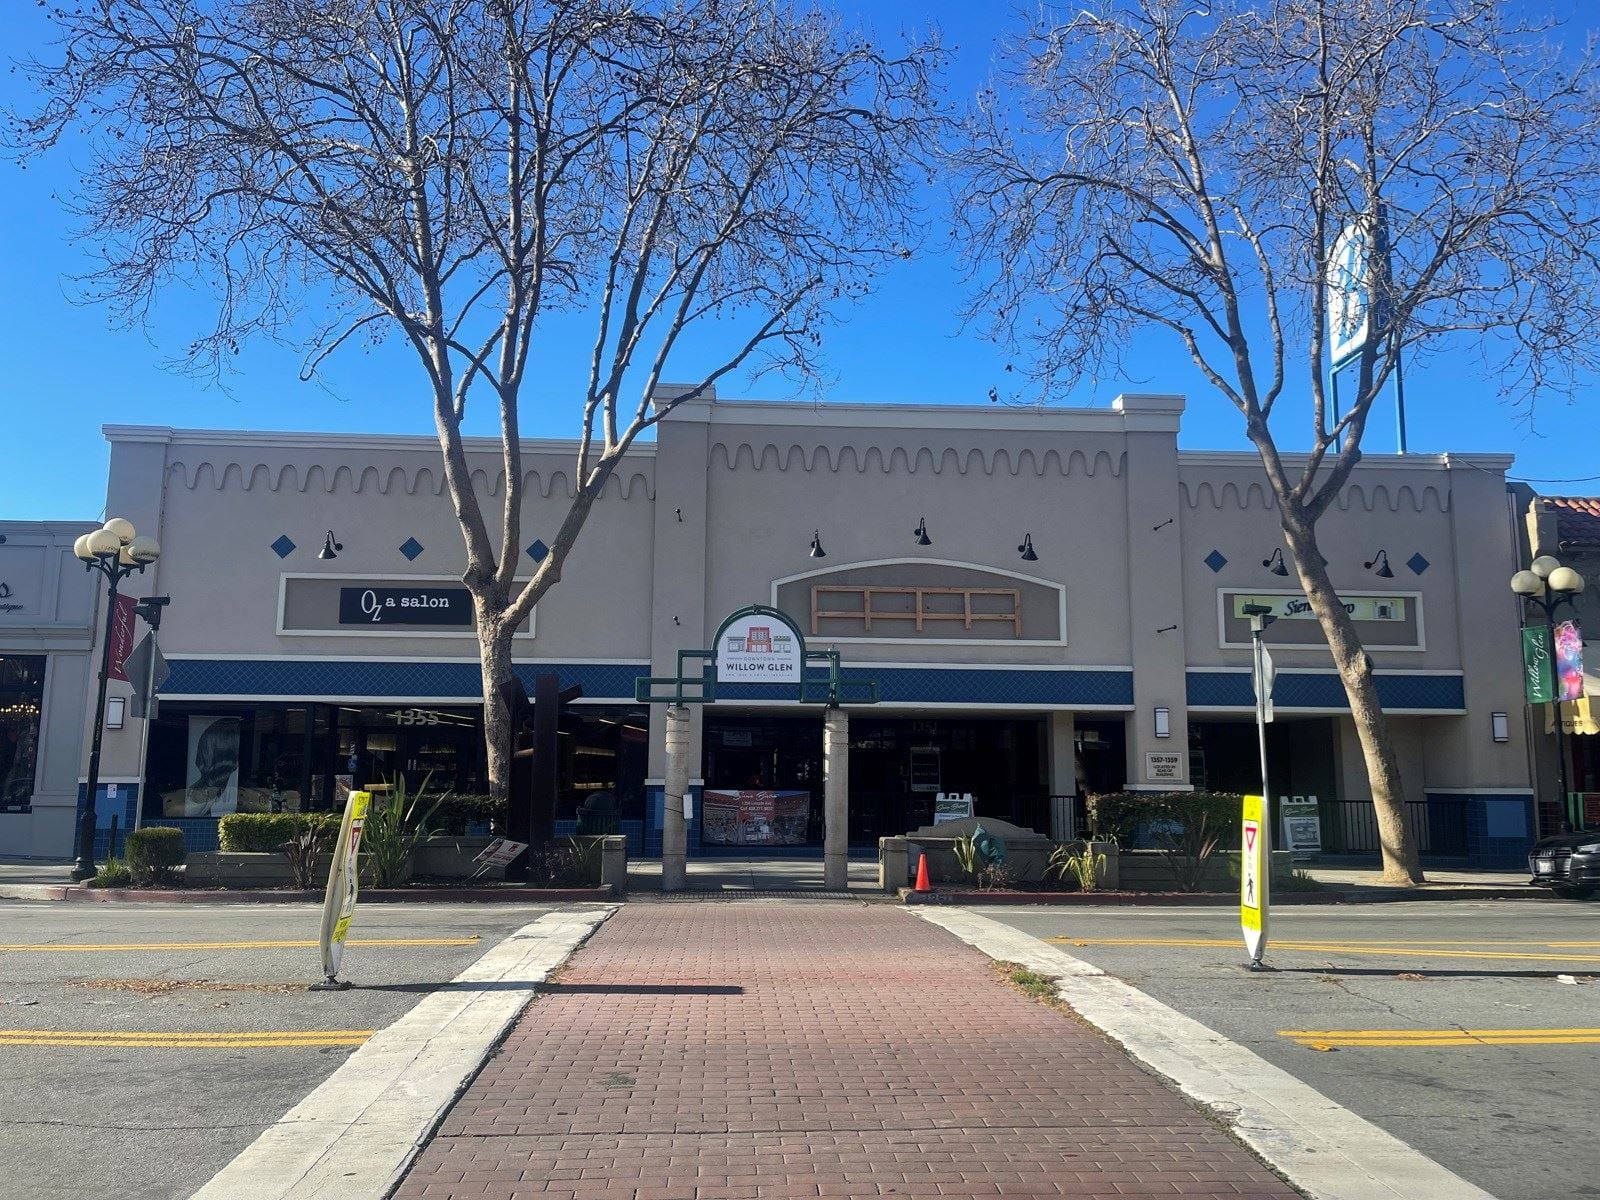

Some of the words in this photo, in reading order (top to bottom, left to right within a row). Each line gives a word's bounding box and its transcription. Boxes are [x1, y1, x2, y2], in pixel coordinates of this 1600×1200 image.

[361, 590, 382, 621] Oz
[385, 597, 396, 607] a
[401, 595, 449, 608] salon
[1284, 599, 1313, 616] Sien
[114, 601, 133, 674] Wonderful
[1531, 632, 1549, 660] Glen
[726, 663, 765, 671] WILLOW
[767, 663, 793, 671] GLEN
[1527, 656, 1542, 698] Willow
[394, 710, 439, 725] 1355
